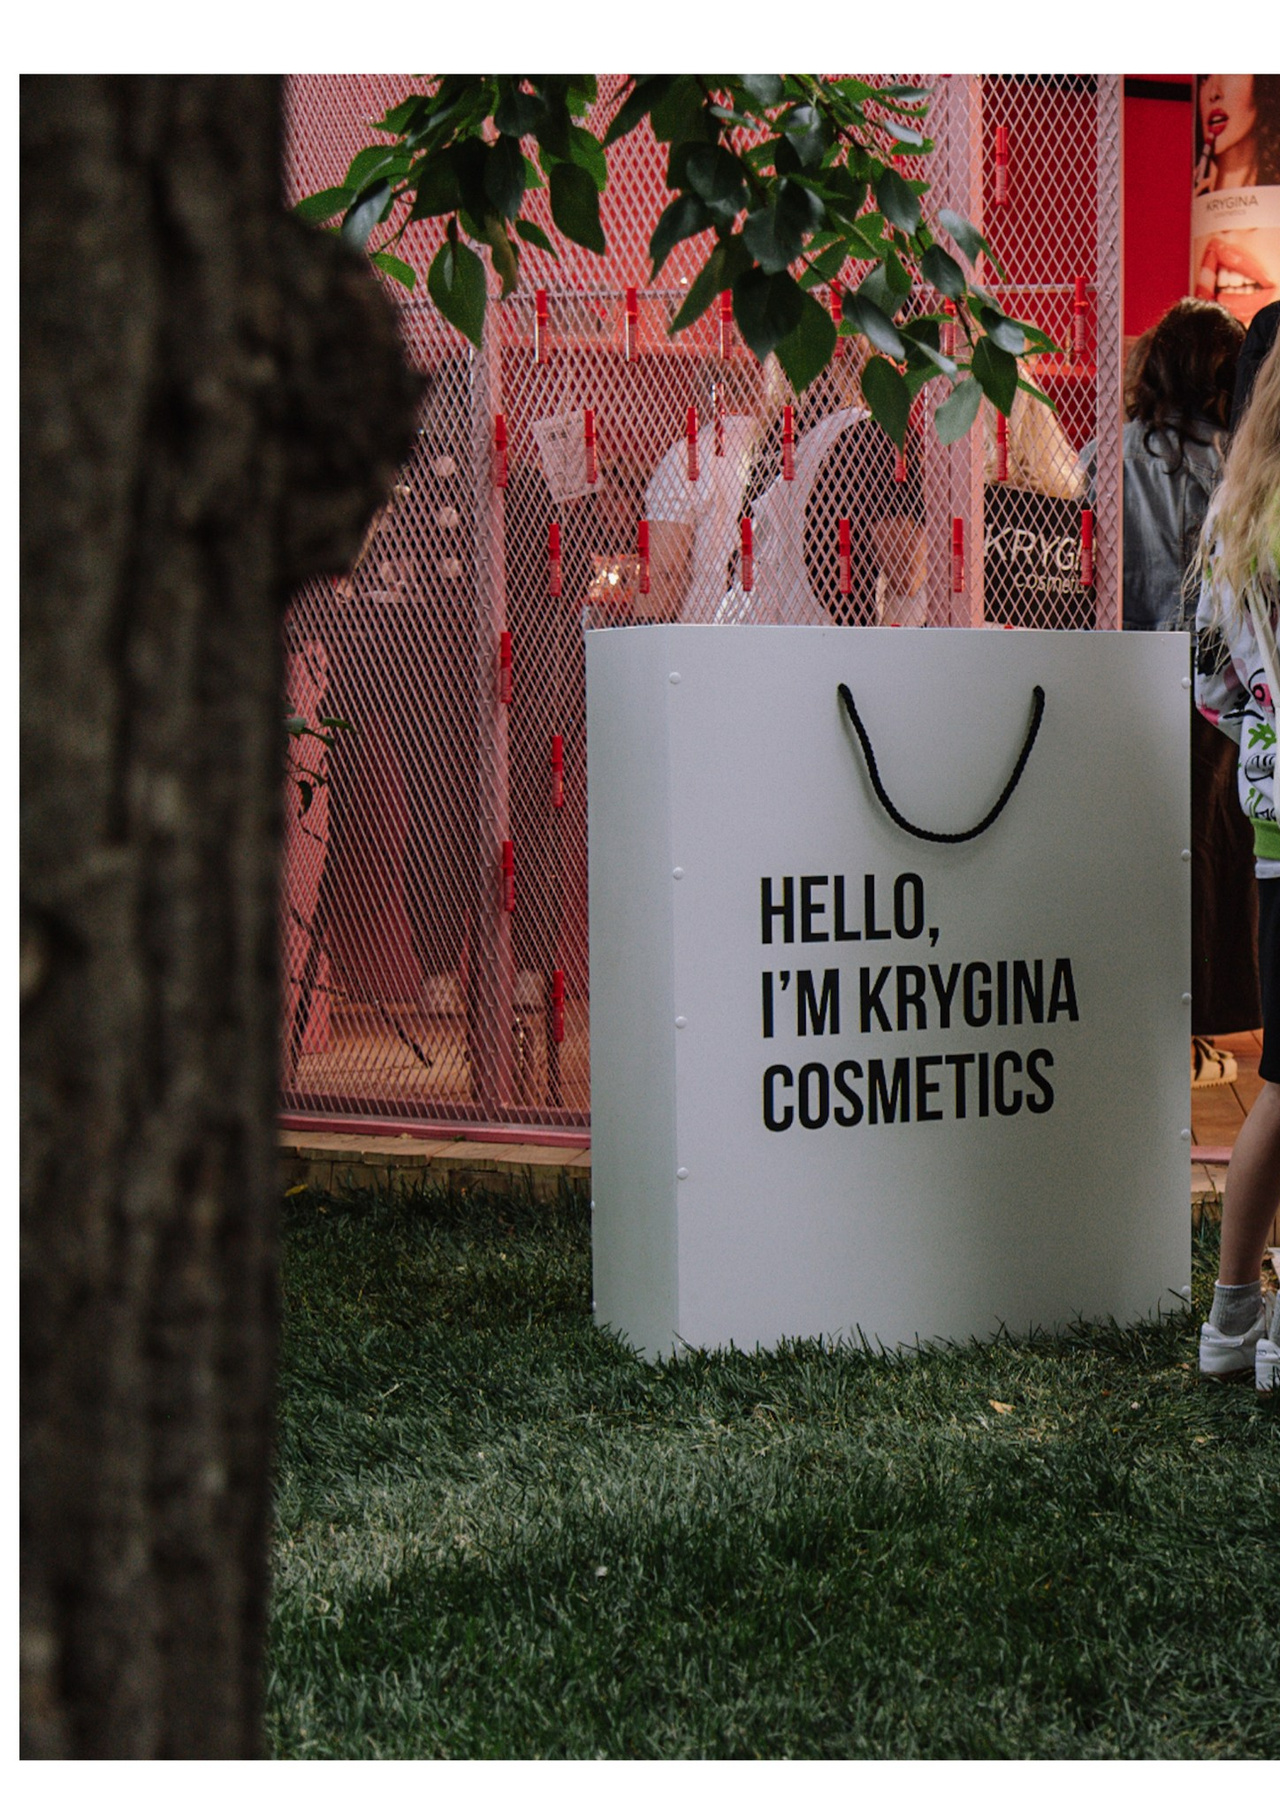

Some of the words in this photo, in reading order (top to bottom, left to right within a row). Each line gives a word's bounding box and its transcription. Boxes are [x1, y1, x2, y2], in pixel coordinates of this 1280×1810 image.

[760, 872, 940, 948] HELLO,
[859, 957, 1080, 1033] KRYGINA
[762, 1048, 1055, 1132] COSMETICS
